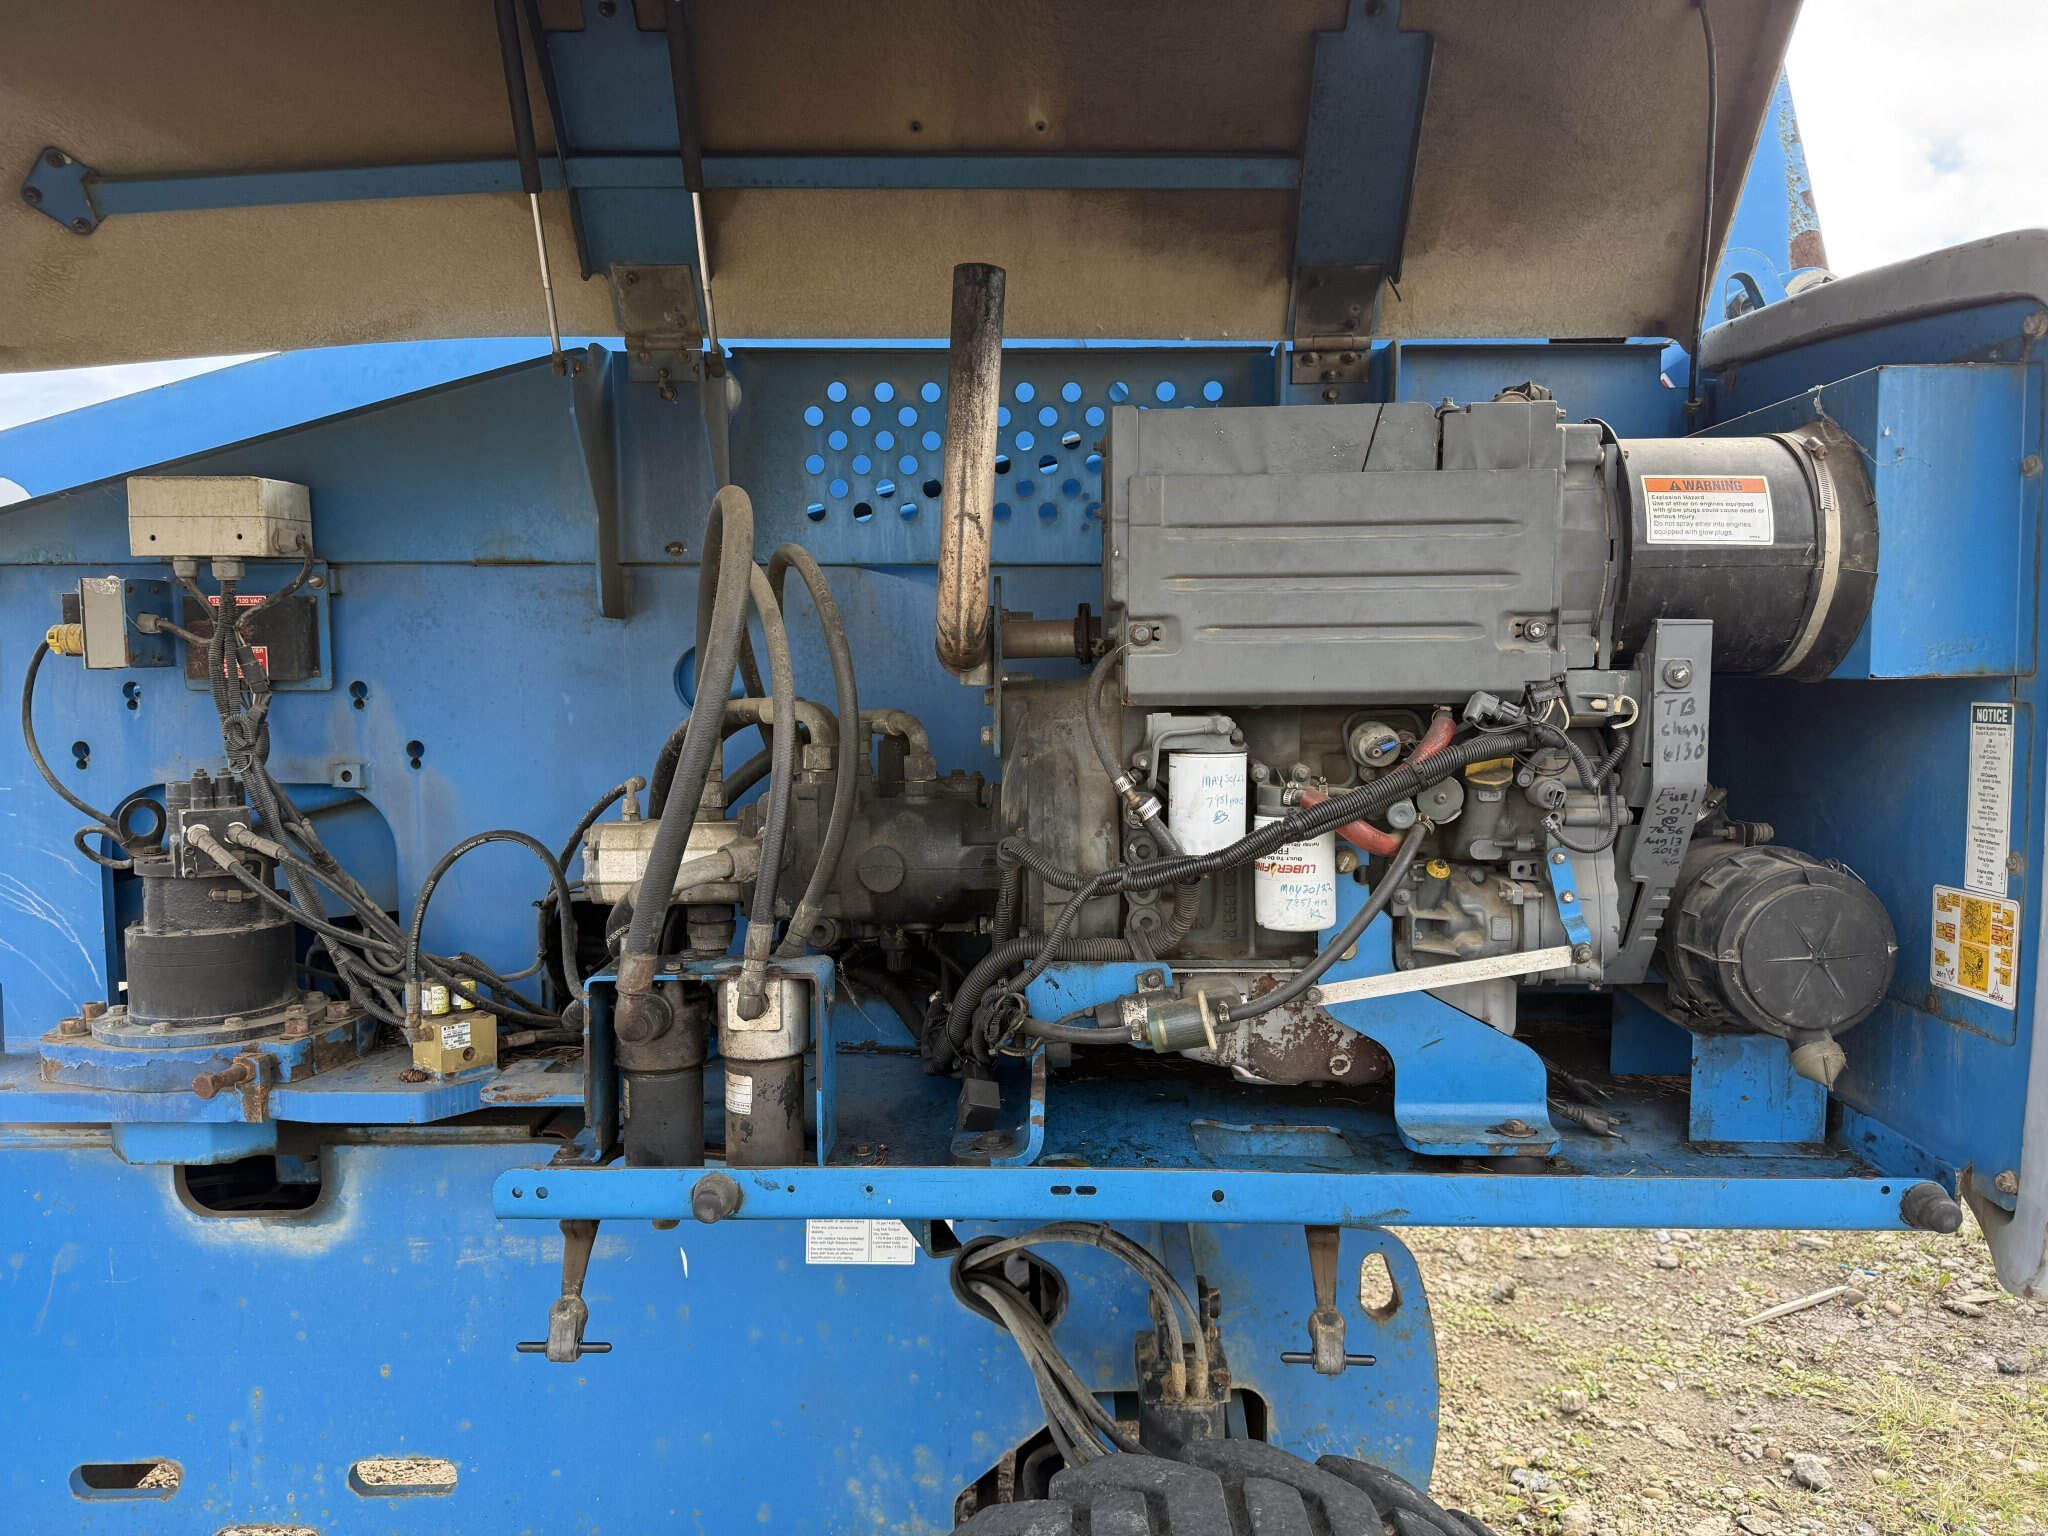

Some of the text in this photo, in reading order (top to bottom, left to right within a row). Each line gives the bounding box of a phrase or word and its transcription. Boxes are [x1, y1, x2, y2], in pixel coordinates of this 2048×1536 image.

[1682, 480, 1742, 491] WARNING
[1977, 709, 2008, 722] NOTICE
[1656, 787, 1697, 803] Fuel
[1649, 826, 1686, 834] 7656
[1936, 970, 1946, 978] 2011
